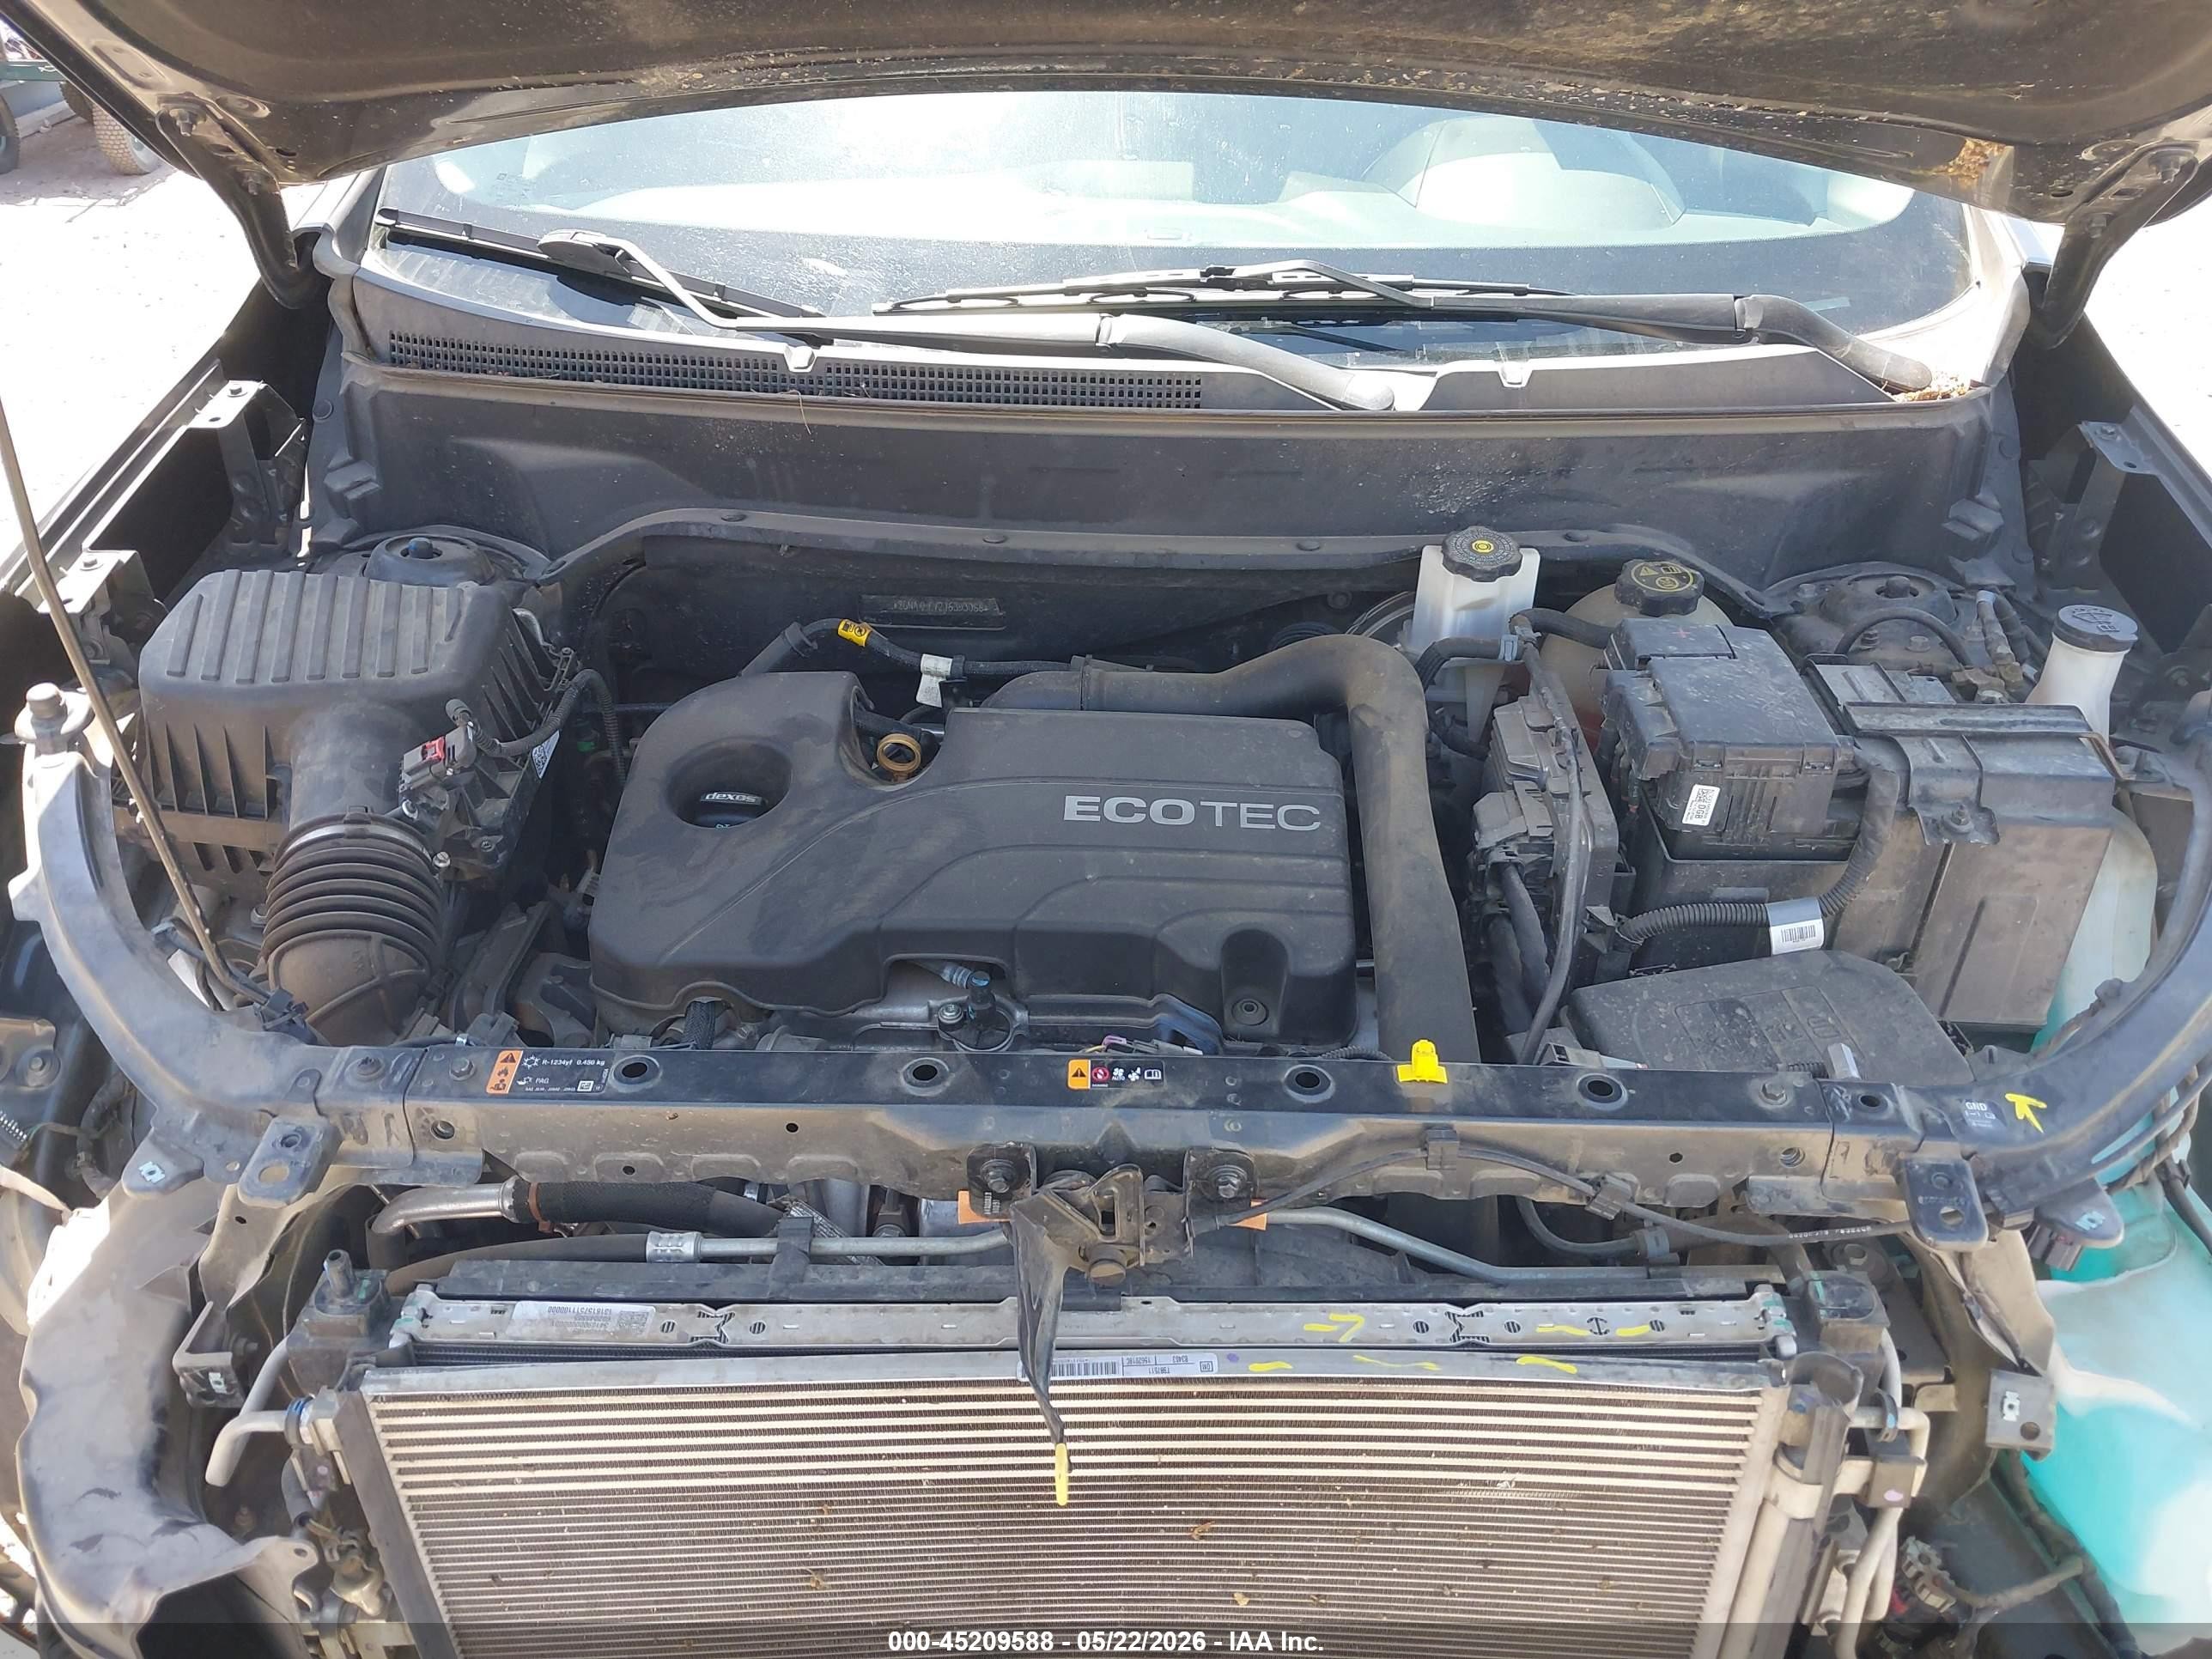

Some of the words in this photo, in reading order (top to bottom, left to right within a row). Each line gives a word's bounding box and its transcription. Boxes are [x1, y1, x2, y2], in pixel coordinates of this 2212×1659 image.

[705, 792, 757, 803] dexos
[1063, 795, 1321, 831] ECOTEC
[1966, 1102, 1987, 1110] GND
